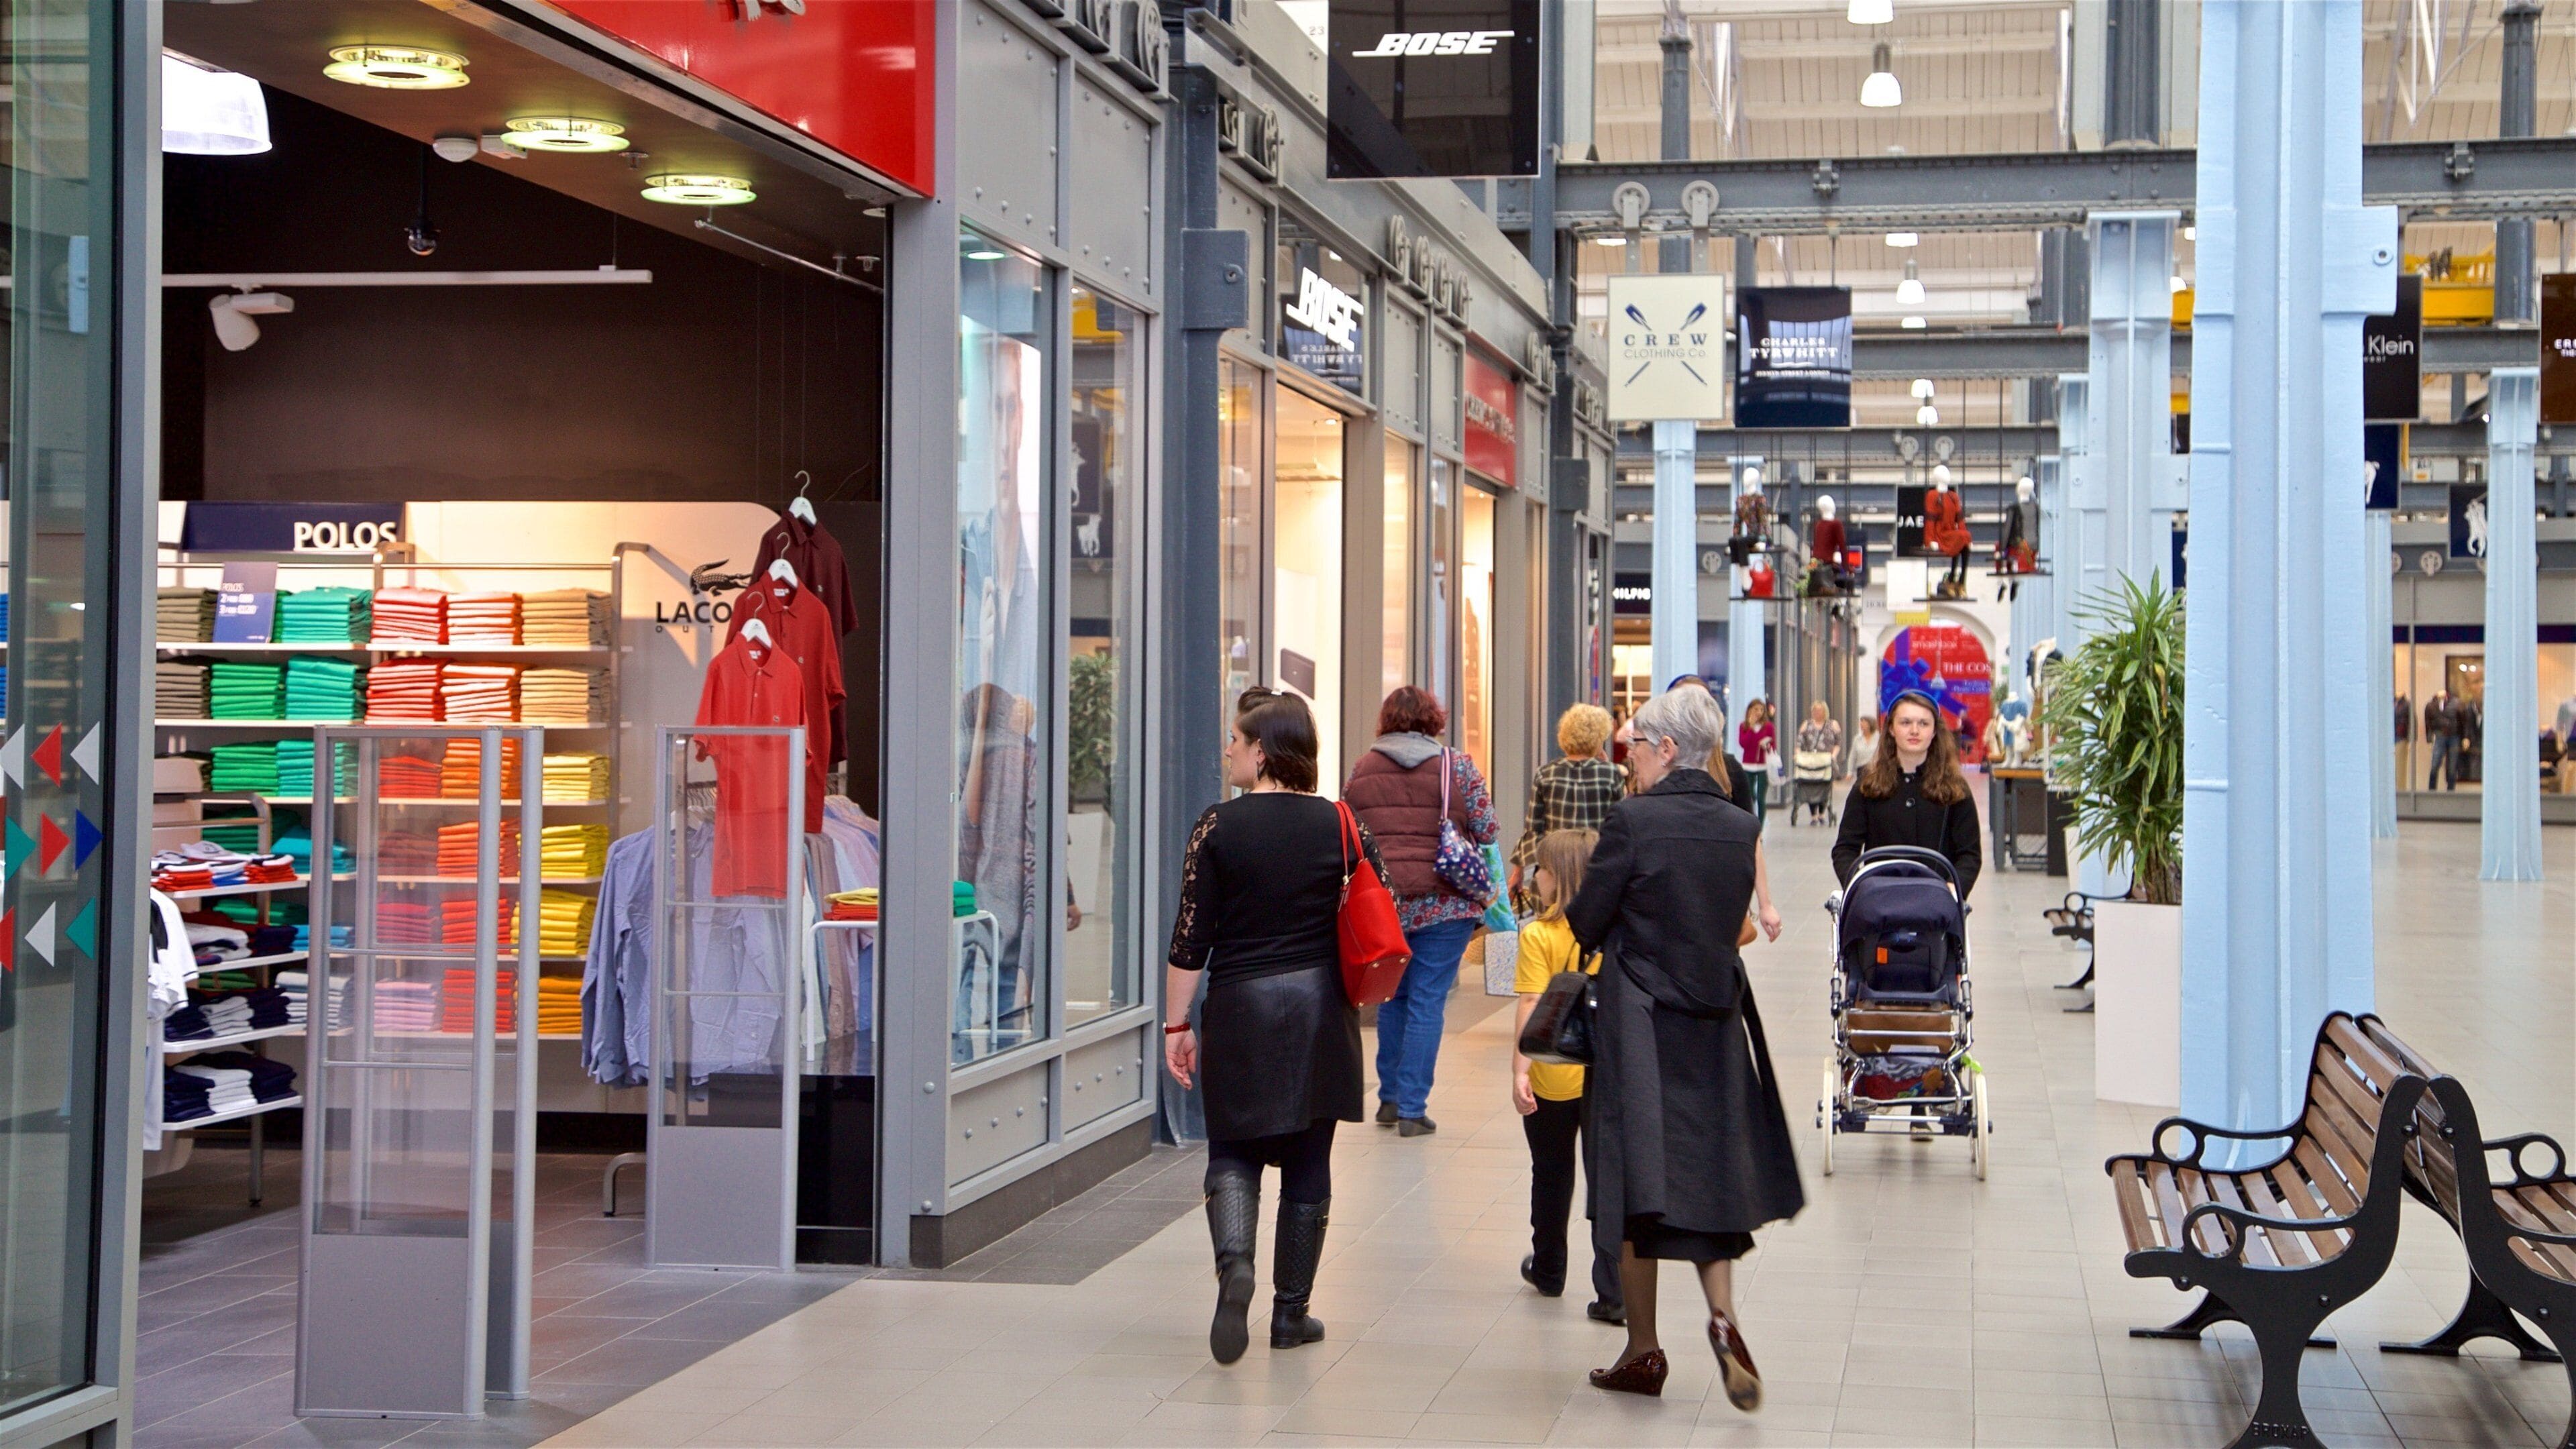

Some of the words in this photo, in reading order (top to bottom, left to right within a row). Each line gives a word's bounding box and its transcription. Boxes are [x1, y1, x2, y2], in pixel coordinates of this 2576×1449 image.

[1352, 30, 1515, 57] BOSE
[1286, 266, 1364, 352] BOSE
[1624, 333, 1708, 346] CREW
[1760, 337, 1825, 347] CHARLES
[2368, 335, 2414, 356] Klein
[1624, 349, 1684, 359] CLOTHING
[1750, 347, 1838, 359] TYRWHITT
[1898, 515, 1925, 528] JAE
[294, 521, 397, 551] POLOS
[222, 583, 244, 592] POLOS
[1613, 587, 1652, 600] HILFIG
[656, 601, 733, 623] LACO
[1943, 661, 1963, 672] THE
[1966, 661, 1992, 673] COS
[2252, 1421, 2308, 1438] BROXAP
